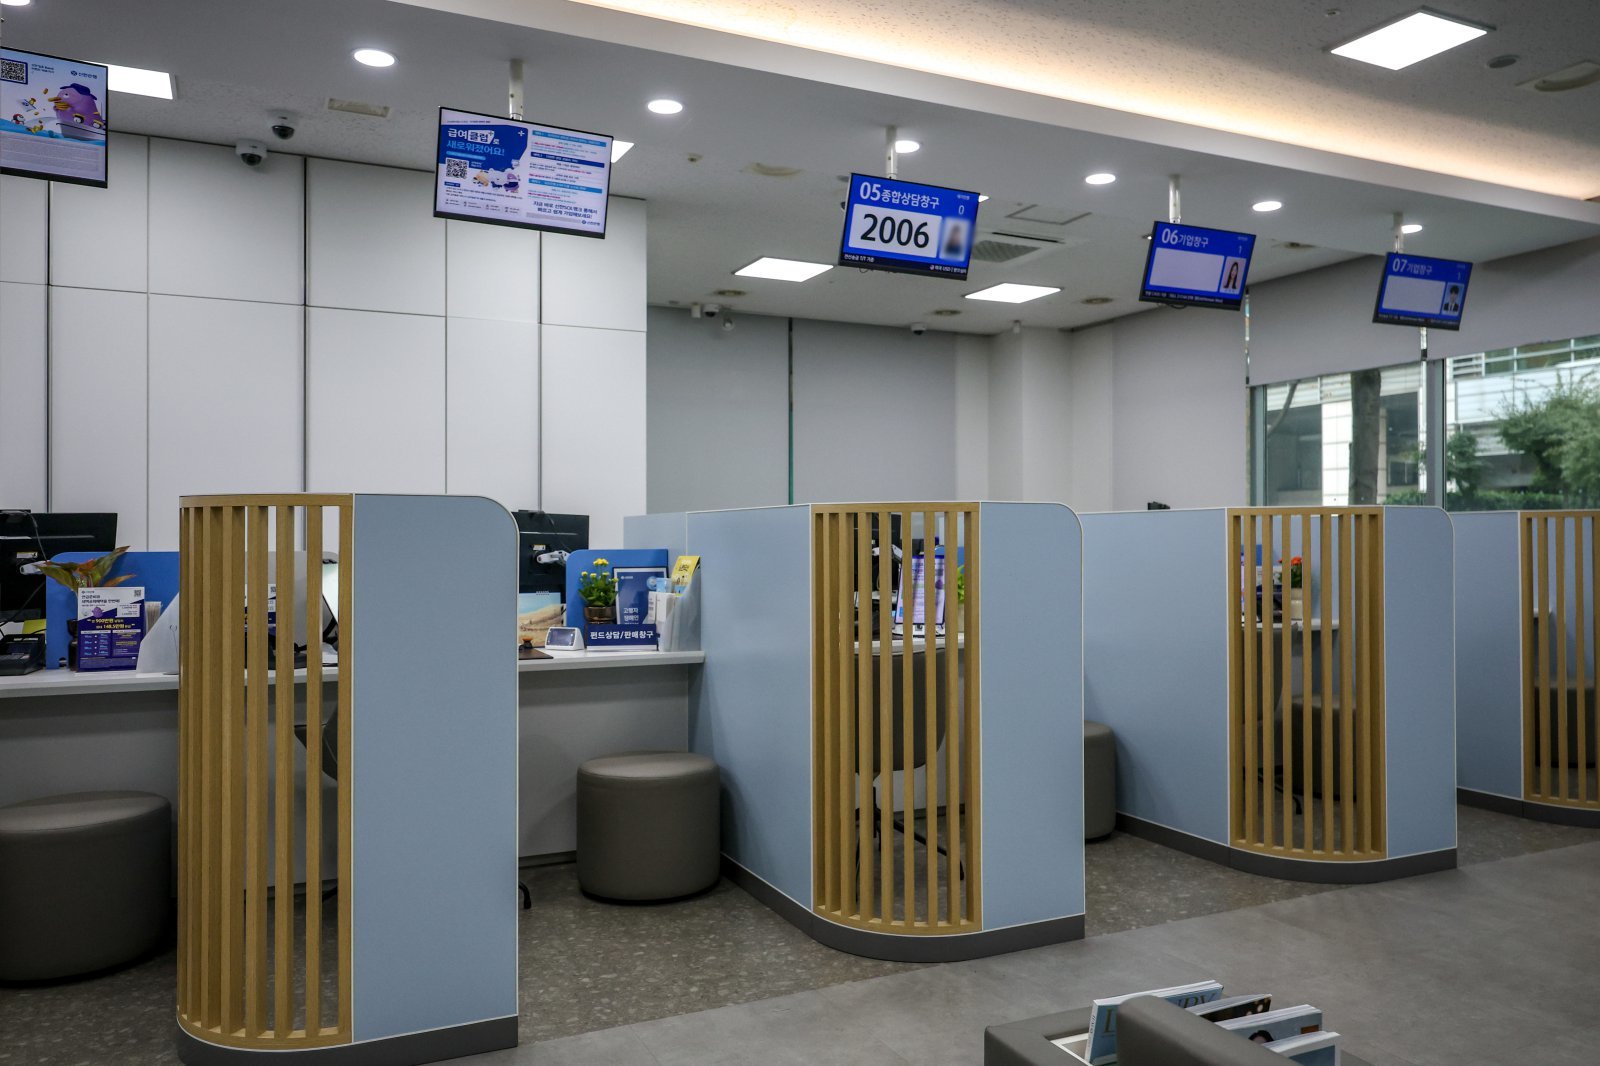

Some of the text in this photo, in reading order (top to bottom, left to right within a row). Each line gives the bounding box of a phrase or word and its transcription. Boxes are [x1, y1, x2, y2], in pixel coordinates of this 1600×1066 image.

[446, 140, 505, 156] 새로워졌어요!
[859, 181, 940, 210] 05 종합상담창구
[860, 213, 930, 249] 2006
[1161, 228, 1209, 248] 06 기업창구
[1392, 258, 1408, 272] 07
[589, 630, 655, 641] 펀드상담/판매창구
